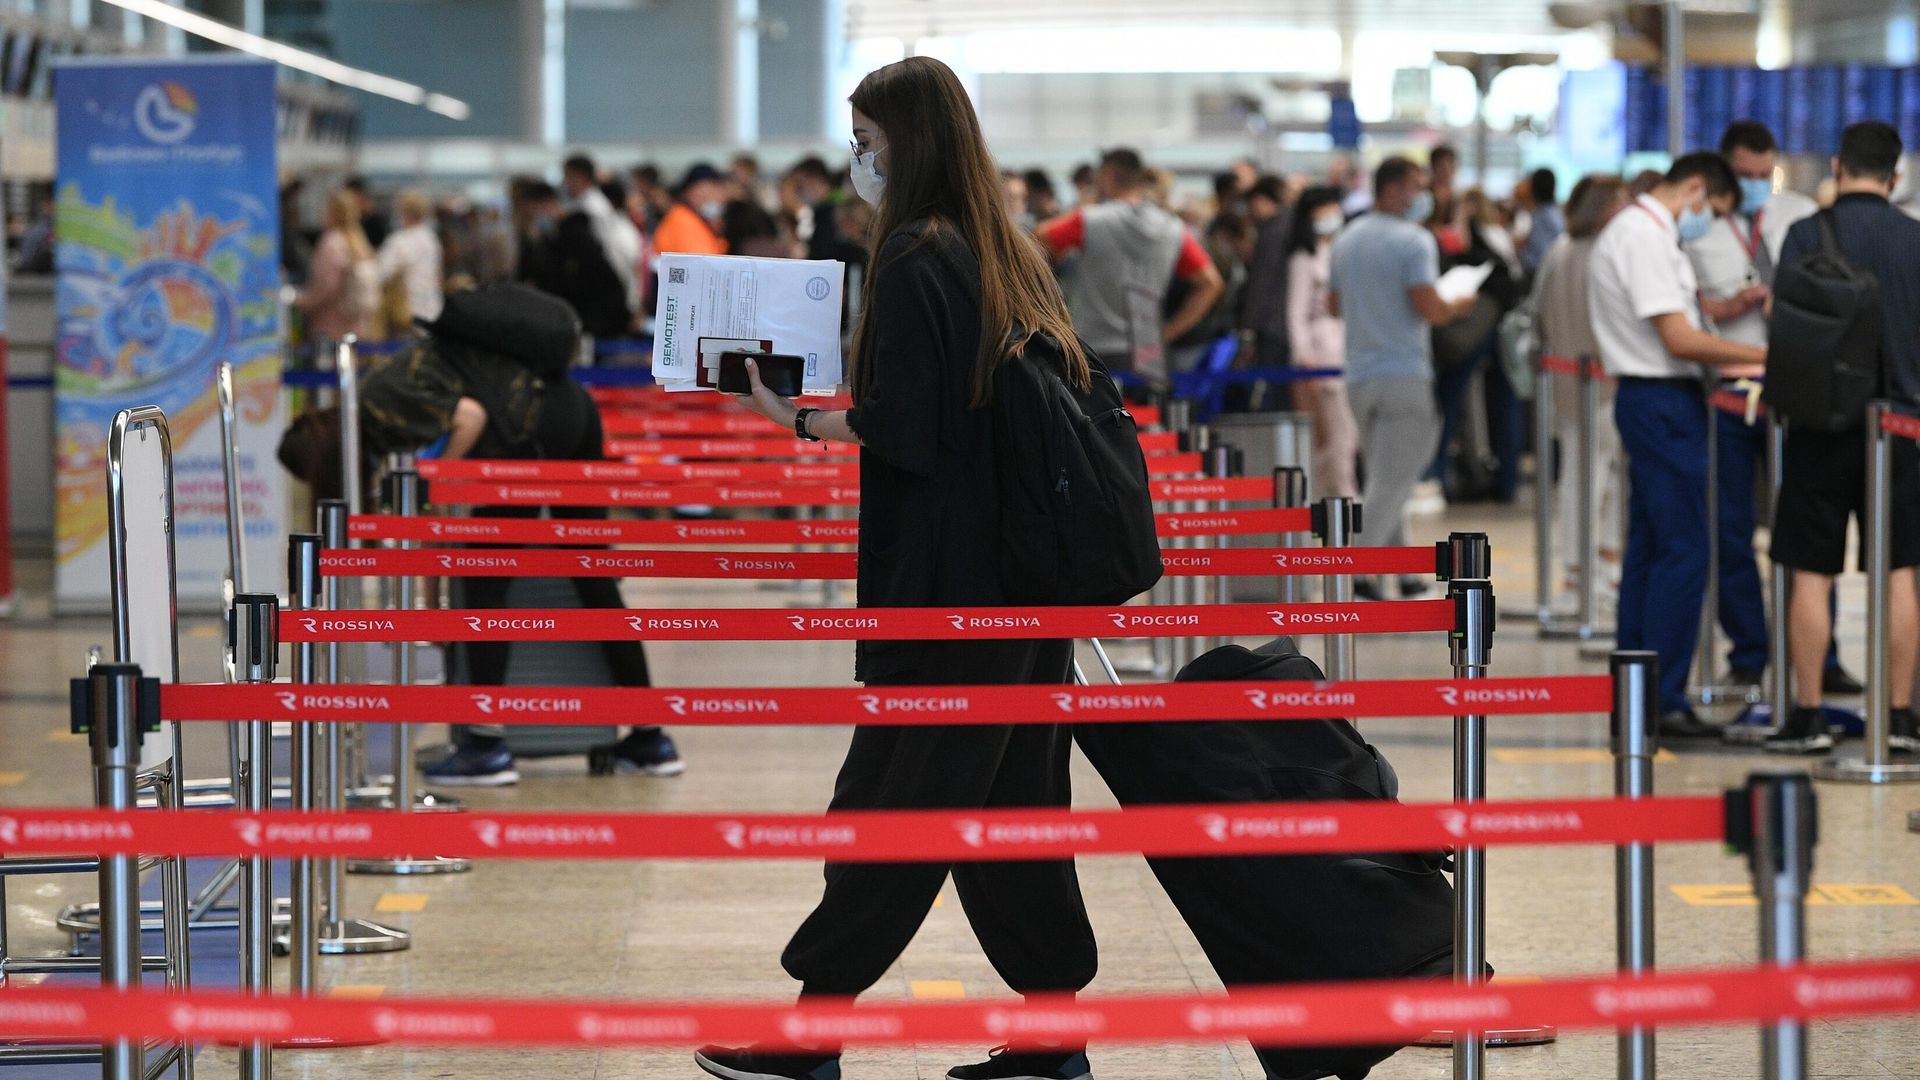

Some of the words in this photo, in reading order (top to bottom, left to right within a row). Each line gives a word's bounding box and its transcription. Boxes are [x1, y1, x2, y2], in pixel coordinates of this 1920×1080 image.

[662, 296, 676, 366] GEMOTEST
[1182, 517, 1238, 528] ROSSIYA
[444, 524, 501, 535] ROSSIYA
[567, 526, 622, 537] РОССИЯ
[690, 526, 746, 537] ROSSIYA
[814, 526, 859, 537] РОССИ
[318, 557, 377, 567] РОССИЯ
[456, 557, 518, 567] ROSSIYA
[595, 558, 655, 568] РОССИЯ
[734, 560, 796, 570] ROSSIYA
[1159, 557, 1211, 567] ОССИЯ
[1292, 555, 1353, 566] ROSSIYA
[970, 617, 1041, 628] ROSSIYA
[1131, 615, 1199, 626] РОССИЯ
[1290, 612, 1360, 623] ROSSIYA
[322, 620, 394, 631] ROSSIYA
[487, 619, 555, 629] РОССИЯ
[648, 619, 719, 629] ROSSIYA
[810, 618, 878, 629] РОССИЯ
[1268, 691, 1356, 707] РОССИЯ
[1463, 688, 1551, 703] ROSSIYA
[302, 695, 390, 709] ROSSIYA
[498, 697, 582, 712] РОССИЯ
[691, 699, 779, 713] ROSSIYA
[884, 697, 969, 712] РОССИЯ
[1078, 695, 1166, 709] ROSSIYA
